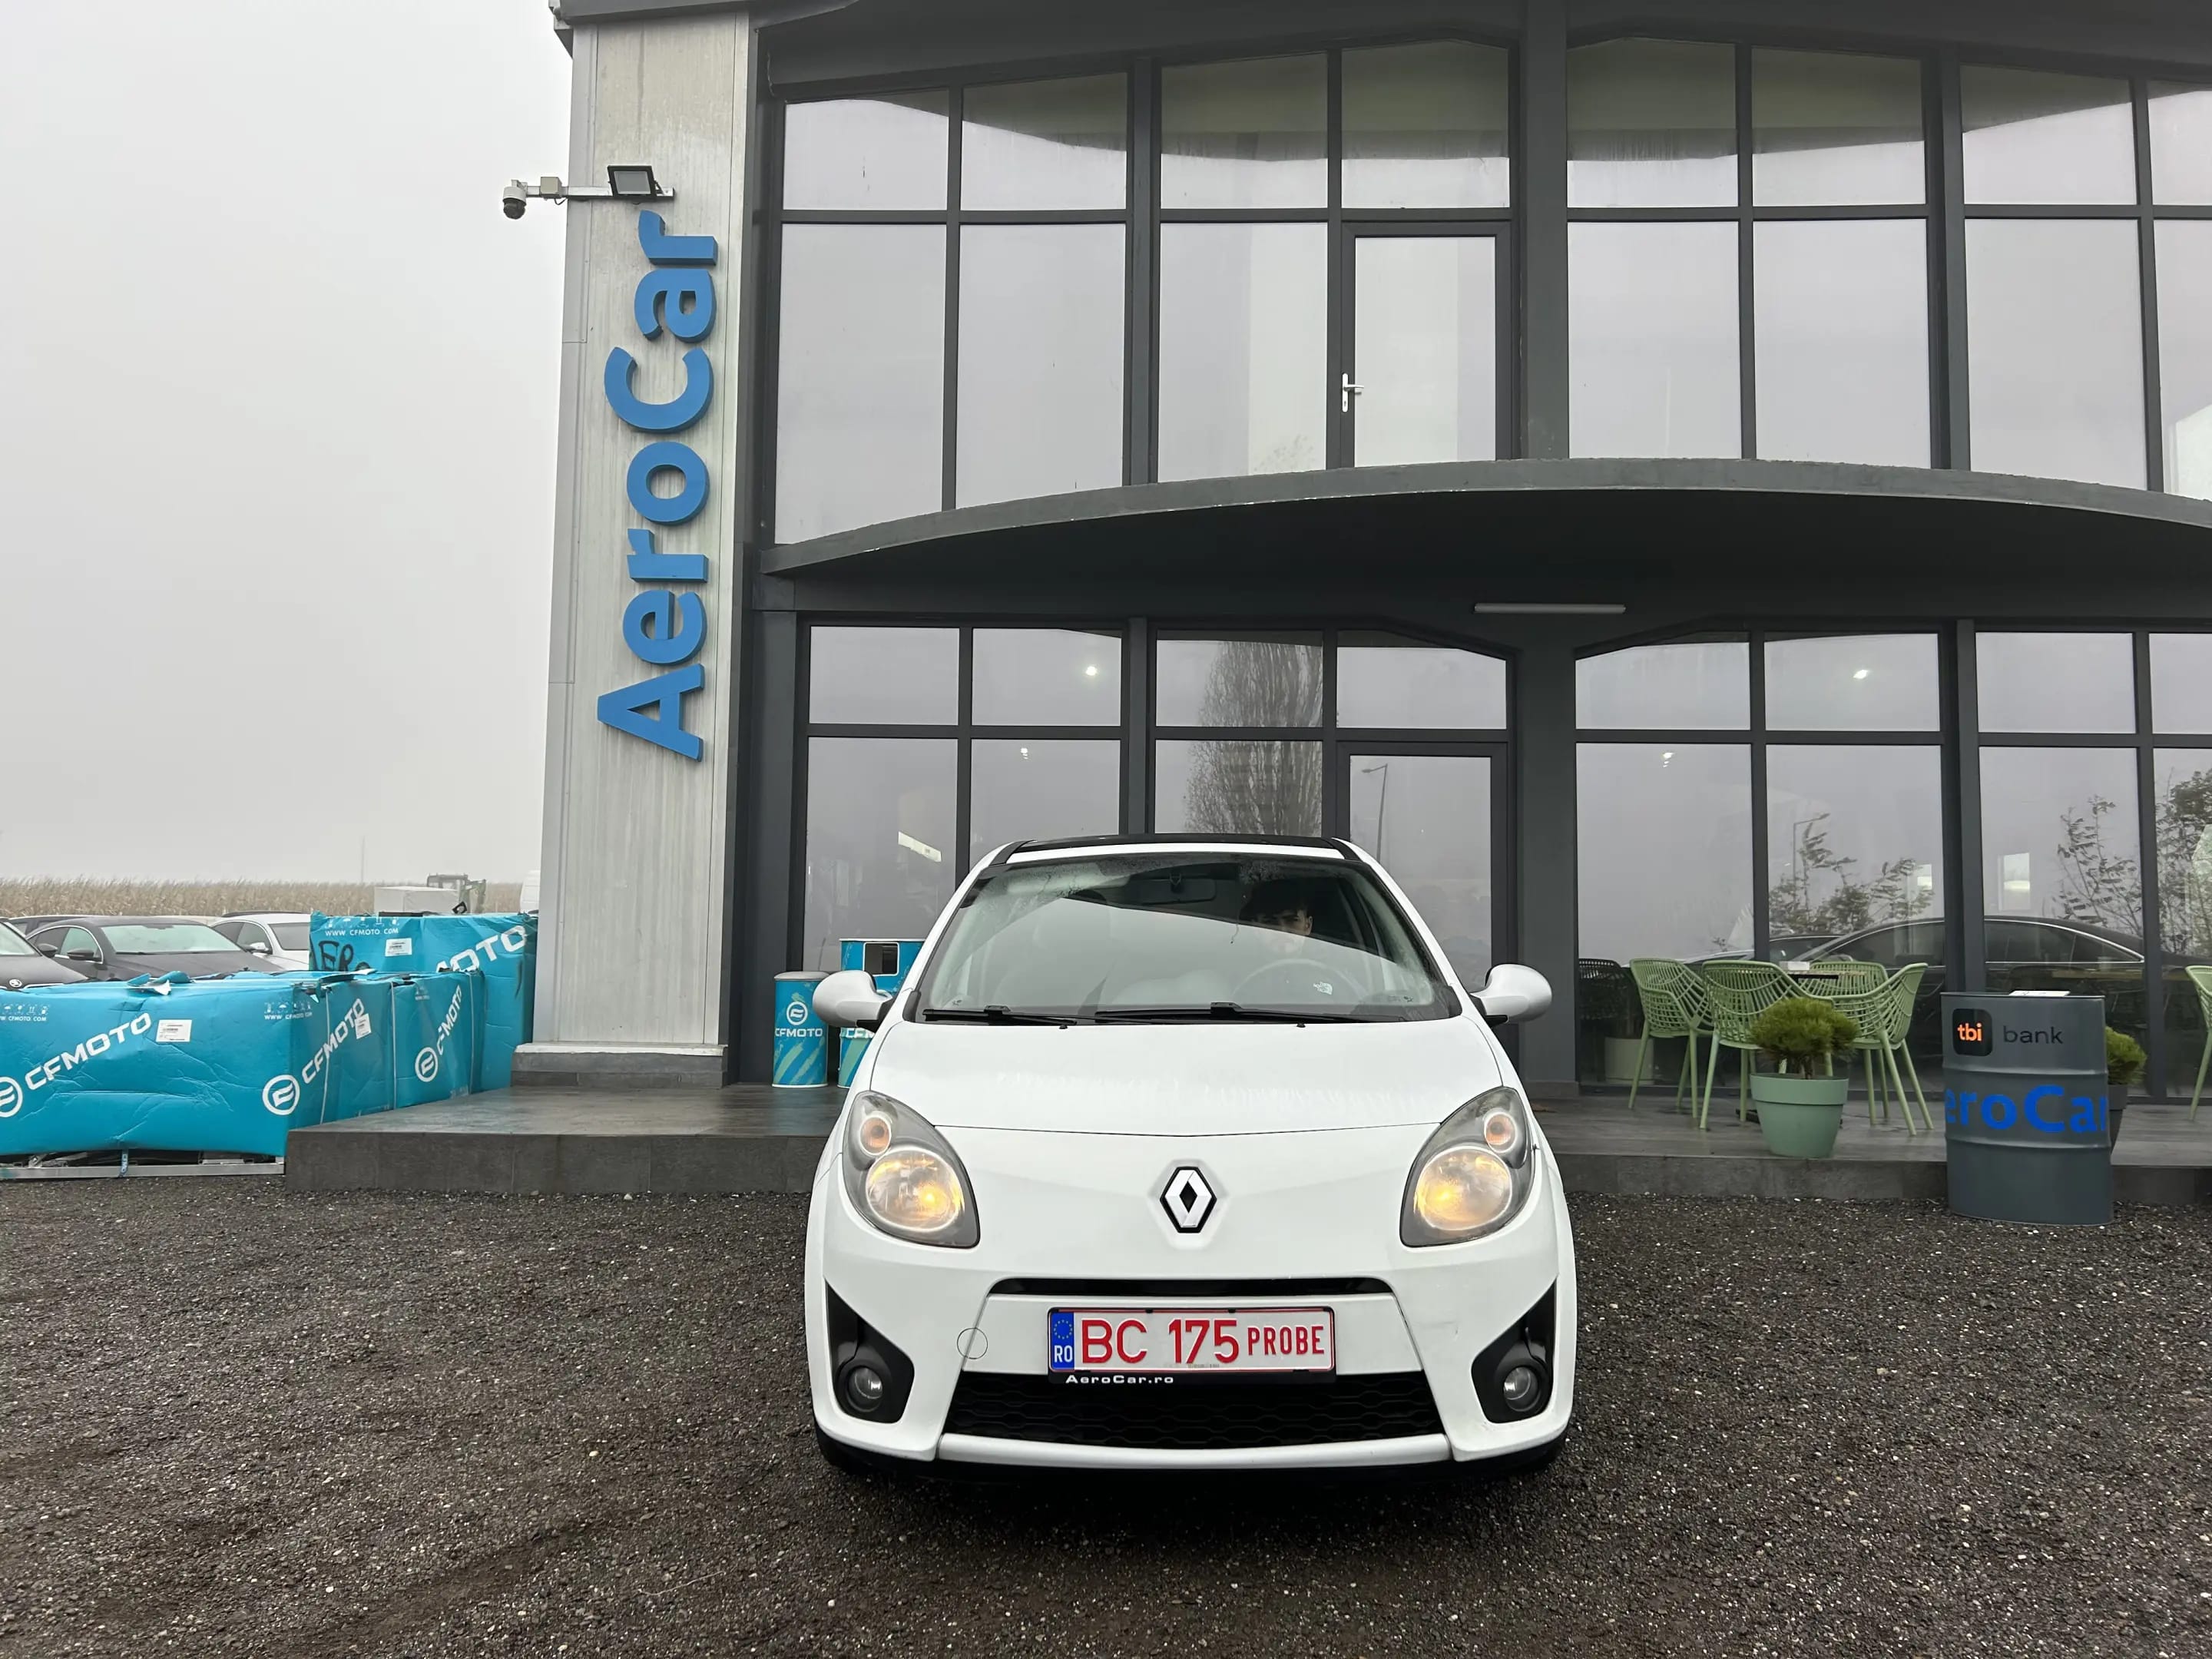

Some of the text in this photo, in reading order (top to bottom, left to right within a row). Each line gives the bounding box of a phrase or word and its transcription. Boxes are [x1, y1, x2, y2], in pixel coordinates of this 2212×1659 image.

[598, 210, 718, 762] AeroCar
[302, 998, 365, 1084] CFMOTO
[775, 1028, 823, 1037] CFMOTO
[1957, 1022, 2063, 1045] tbi bank
[25, 1012, 151, 1090] CFMOTO
[1054, 1345, 1073, 1363] RO
[1081, 1319, 1325, 1364] BC 175 PROBE
[1066, 1374, 1174, 1383] AeroCar.ro
